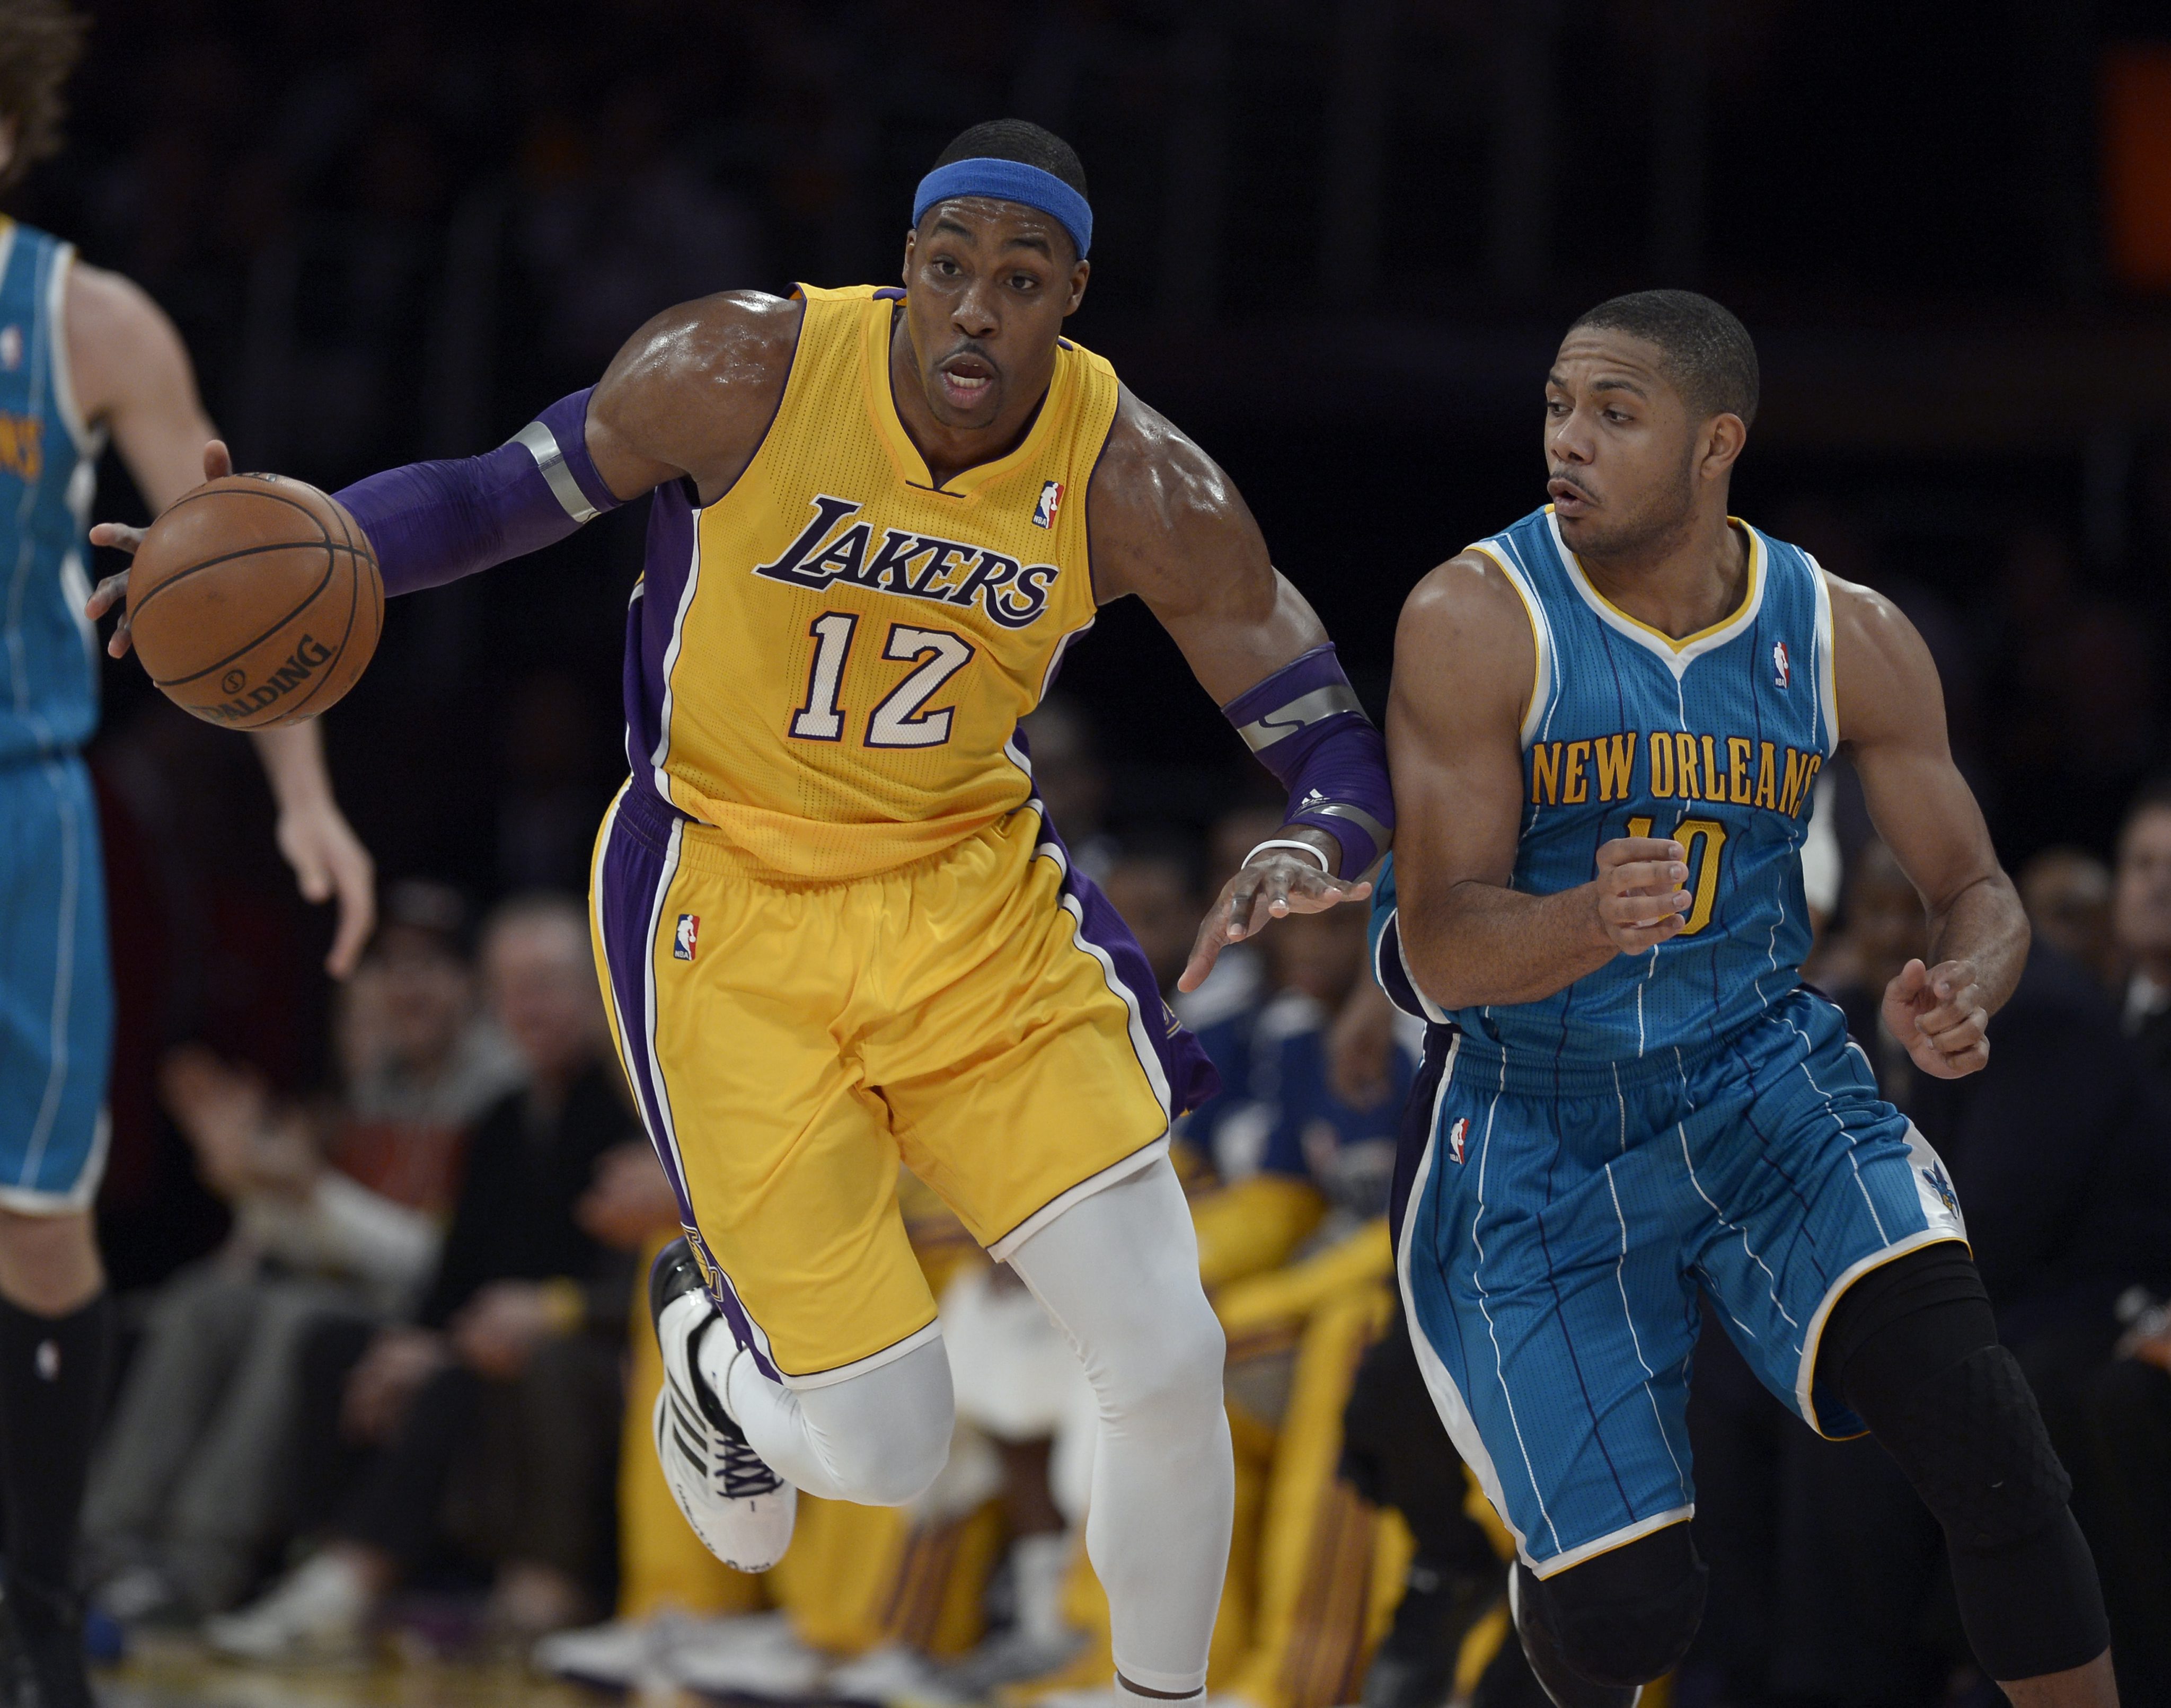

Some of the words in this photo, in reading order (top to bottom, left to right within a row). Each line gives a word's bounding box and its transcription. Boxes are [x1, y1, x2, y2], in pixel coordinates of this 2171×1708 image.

[751, 493, 1061, 629] LAKERS
[1033, 515, 1046, 526] NBA
[788, 610, 976, 748] 12
[1531, 732, 1637, 805] NEW
[1648, 731, 1822, 819] ORLEANS
[1626, 816, 1727, 936] 0
